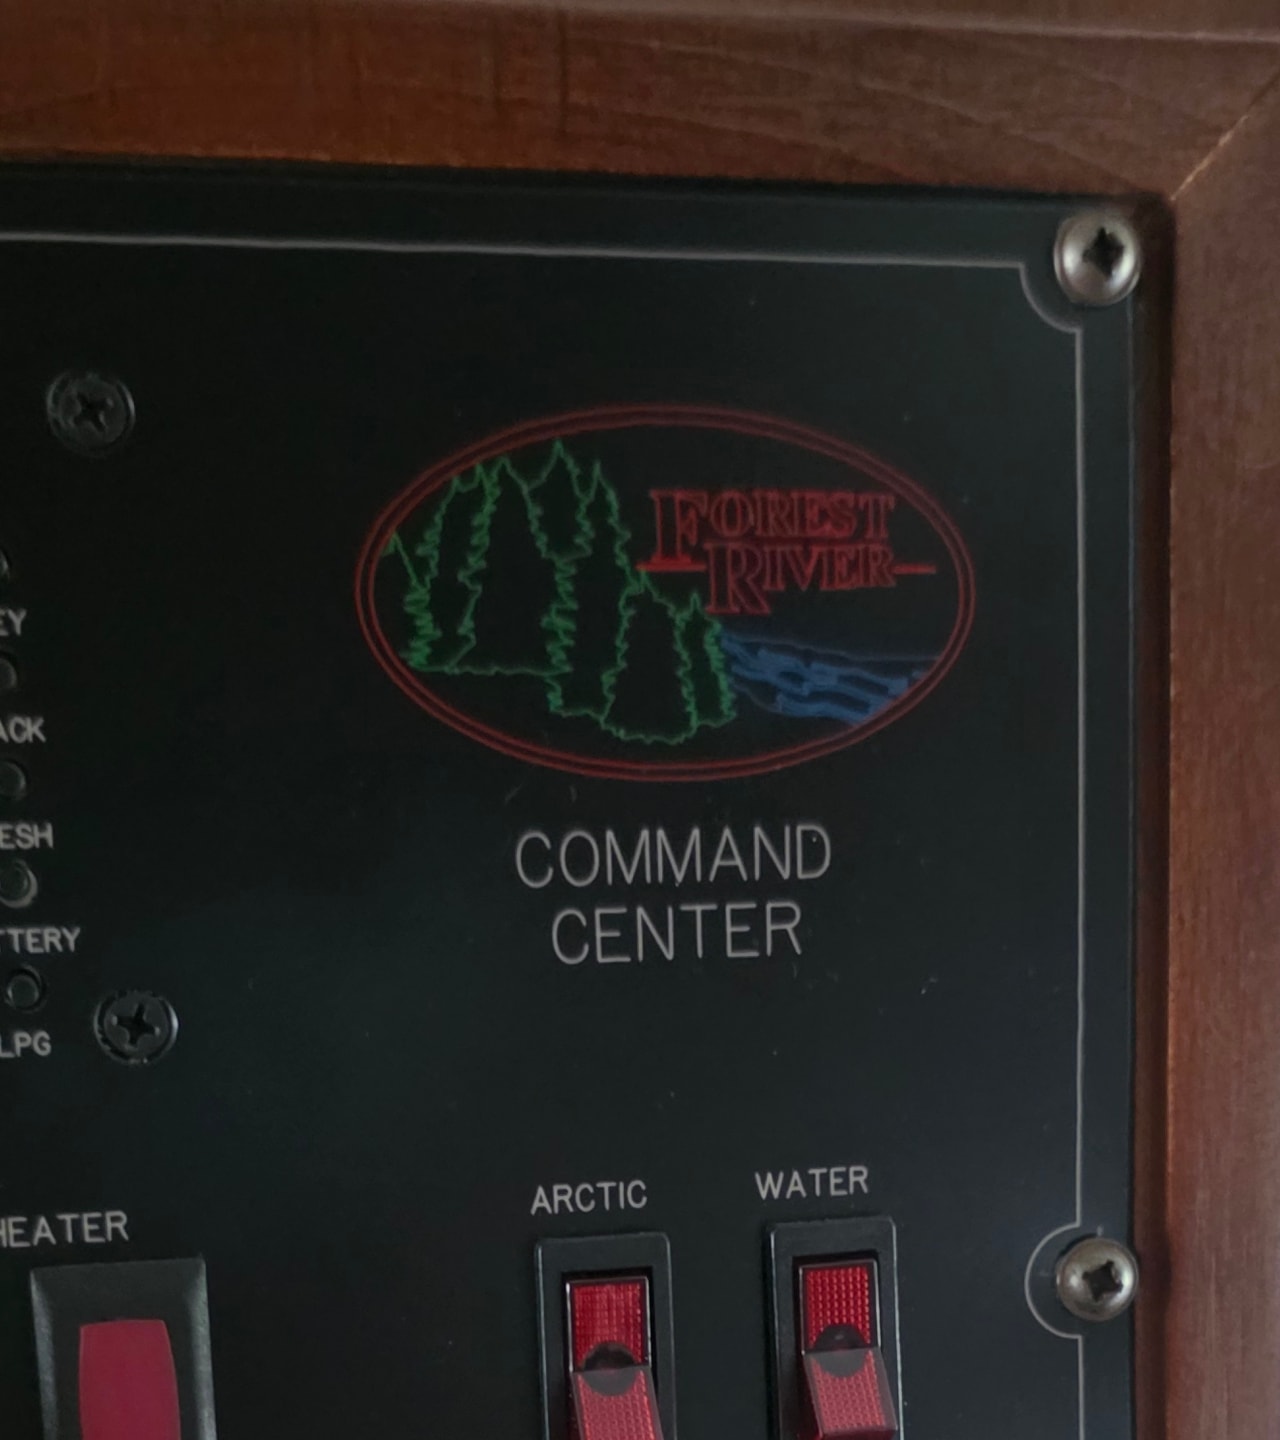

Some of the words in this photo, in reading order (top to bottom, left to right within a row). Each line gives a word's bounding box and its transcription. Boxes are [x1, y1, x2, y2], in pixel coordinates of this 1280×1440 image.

[649, 488, 894, 566] FOREST
[704, 543, 894, 614] RIVER
[514, 823, 832, 889] COMMAND
[551, 899, 803, 965] CENTER
[529, 1179, 649, 1216] ARCTIC
[754, 1165, 870, 1201] WATER
